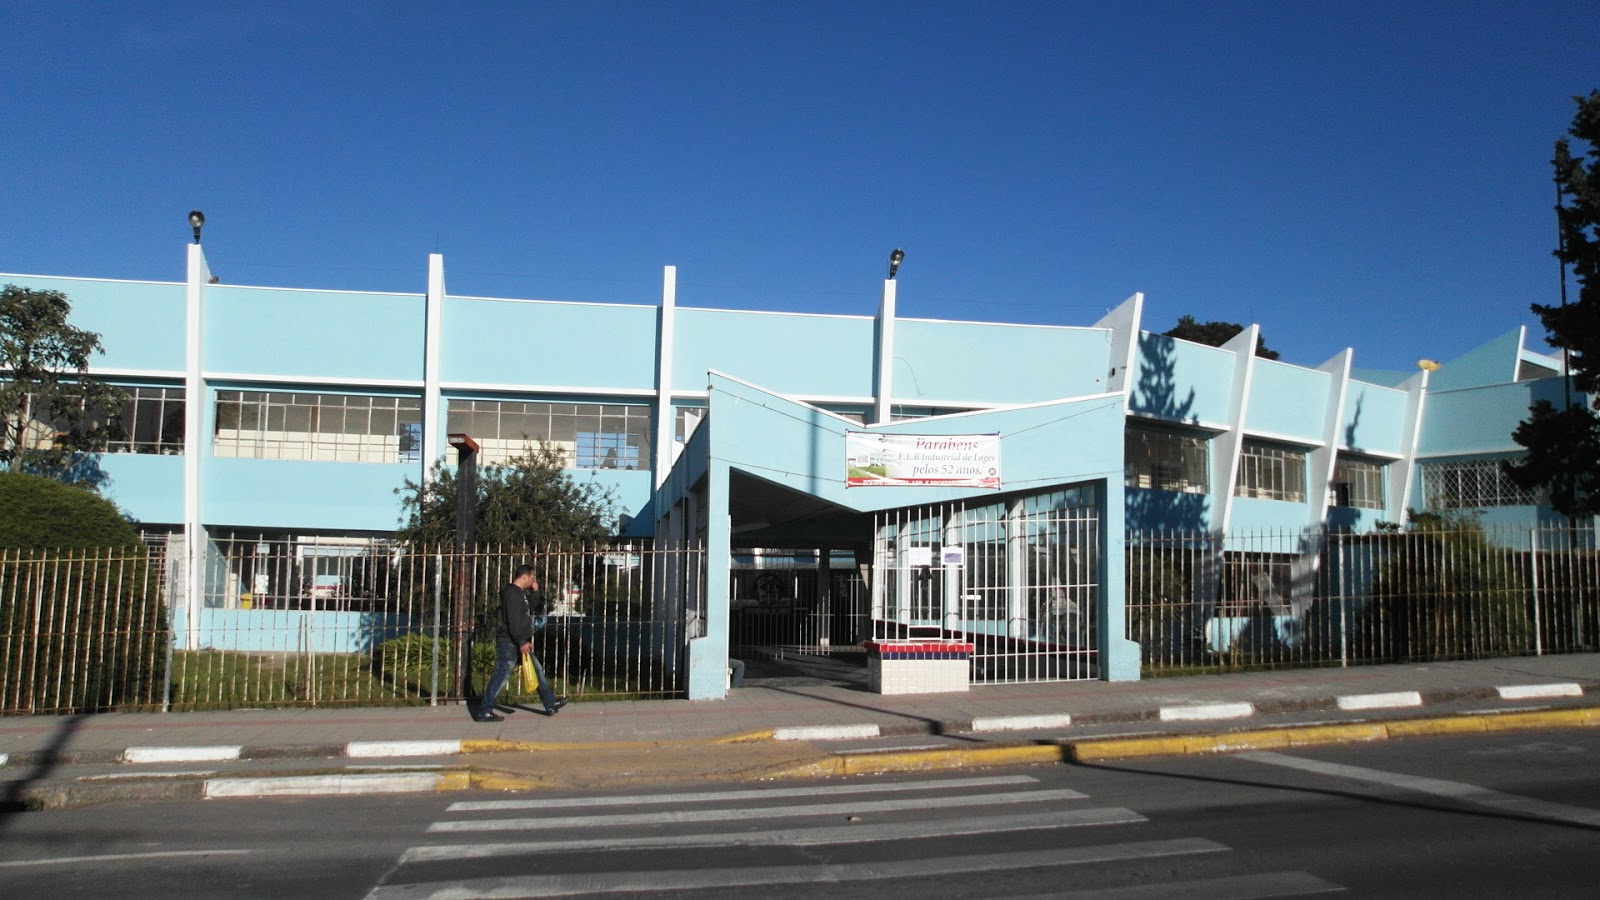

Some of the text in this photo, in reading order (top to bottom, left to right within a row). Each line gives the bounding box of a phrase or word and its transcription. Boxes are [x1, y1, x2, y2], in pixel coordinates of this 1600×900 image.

[921, 452, 961, 461] Industrial
[962, 453, 972, 462] de
[912, 464, 982, 477] pelos 52 anos.
